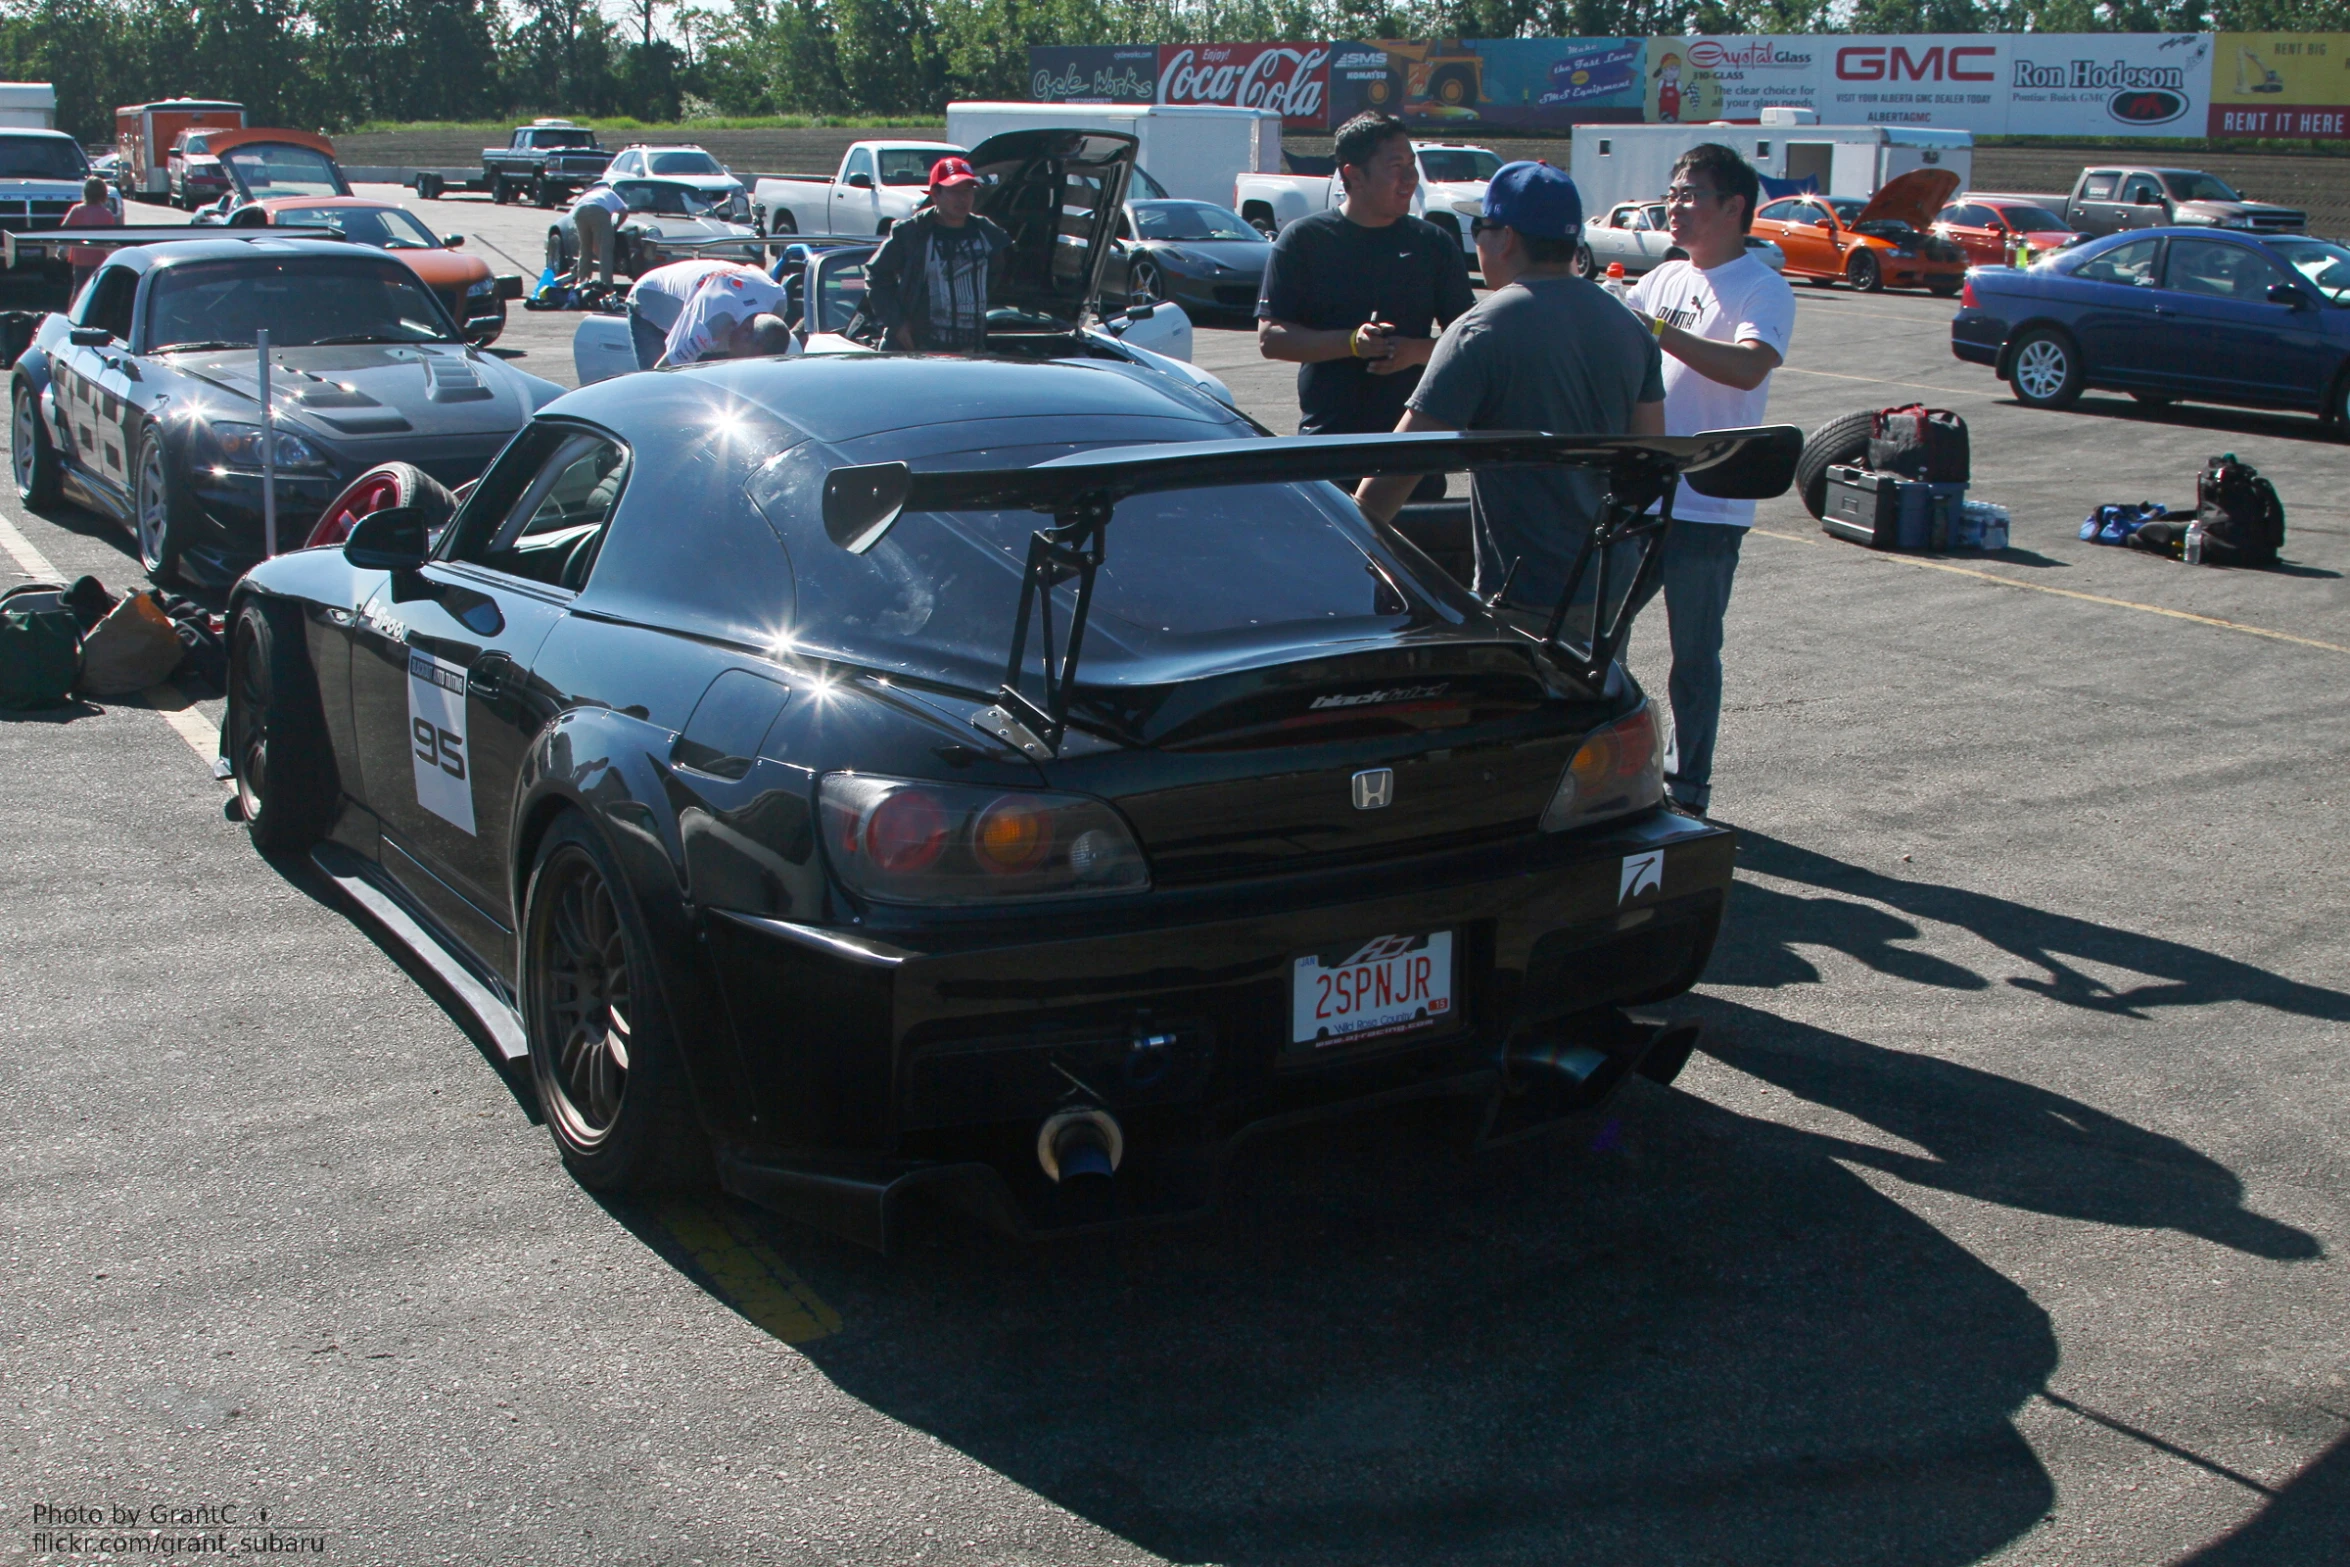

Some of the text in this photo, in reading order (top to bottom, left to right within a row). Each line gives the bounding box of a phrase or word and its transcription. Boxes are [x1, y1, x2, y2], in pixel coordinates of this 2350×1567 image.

[1202, 48, 1231, 63] Enjoy!
[1567, 44, 1598, 55] Make
[1687, 41, 1812, 70] Crystal Glass
[2274, 43, 2327, 56] RENT BIG
[1347, 52, 1388, 64] SMS
[1554, 52, 1634, 74] the Fast Lane
[1836, 46, 1997, 82] GMC
[1157, 47, 1330, 117] Coca-Cola
[1346, 70, 1388, 80] KOMATSU
[2013, 60, 2184, 89] Ron Hodgson
[1033, 62, 1153, 103] Cycle Works
[1713, 85, 1816, 95] The clear choice for
[1539, 79, 1630, 104] SMS Equipment
[1836, 93, 1992, 104] VISIT YOUR ALBERTA GMC DEALER TODAY
[2012, 92, 2108, 102] Pontiac Buick GMC
[1711, 98, 1816, 109] all your glass needs.
[1867, 112, 1932, 122] ALBERTAGMC
[2224, 112, 2345, 133] RENT IT HERE
[413, 716, 466, 781] 95
[1300, 956, 1316, 968] JAN
[1315, 956, 1432, 1020] 2SPNJR
[1435, 999, 1446, 1009] 15
[1333, 1011, 1415, 1034] Wild Rose Country
